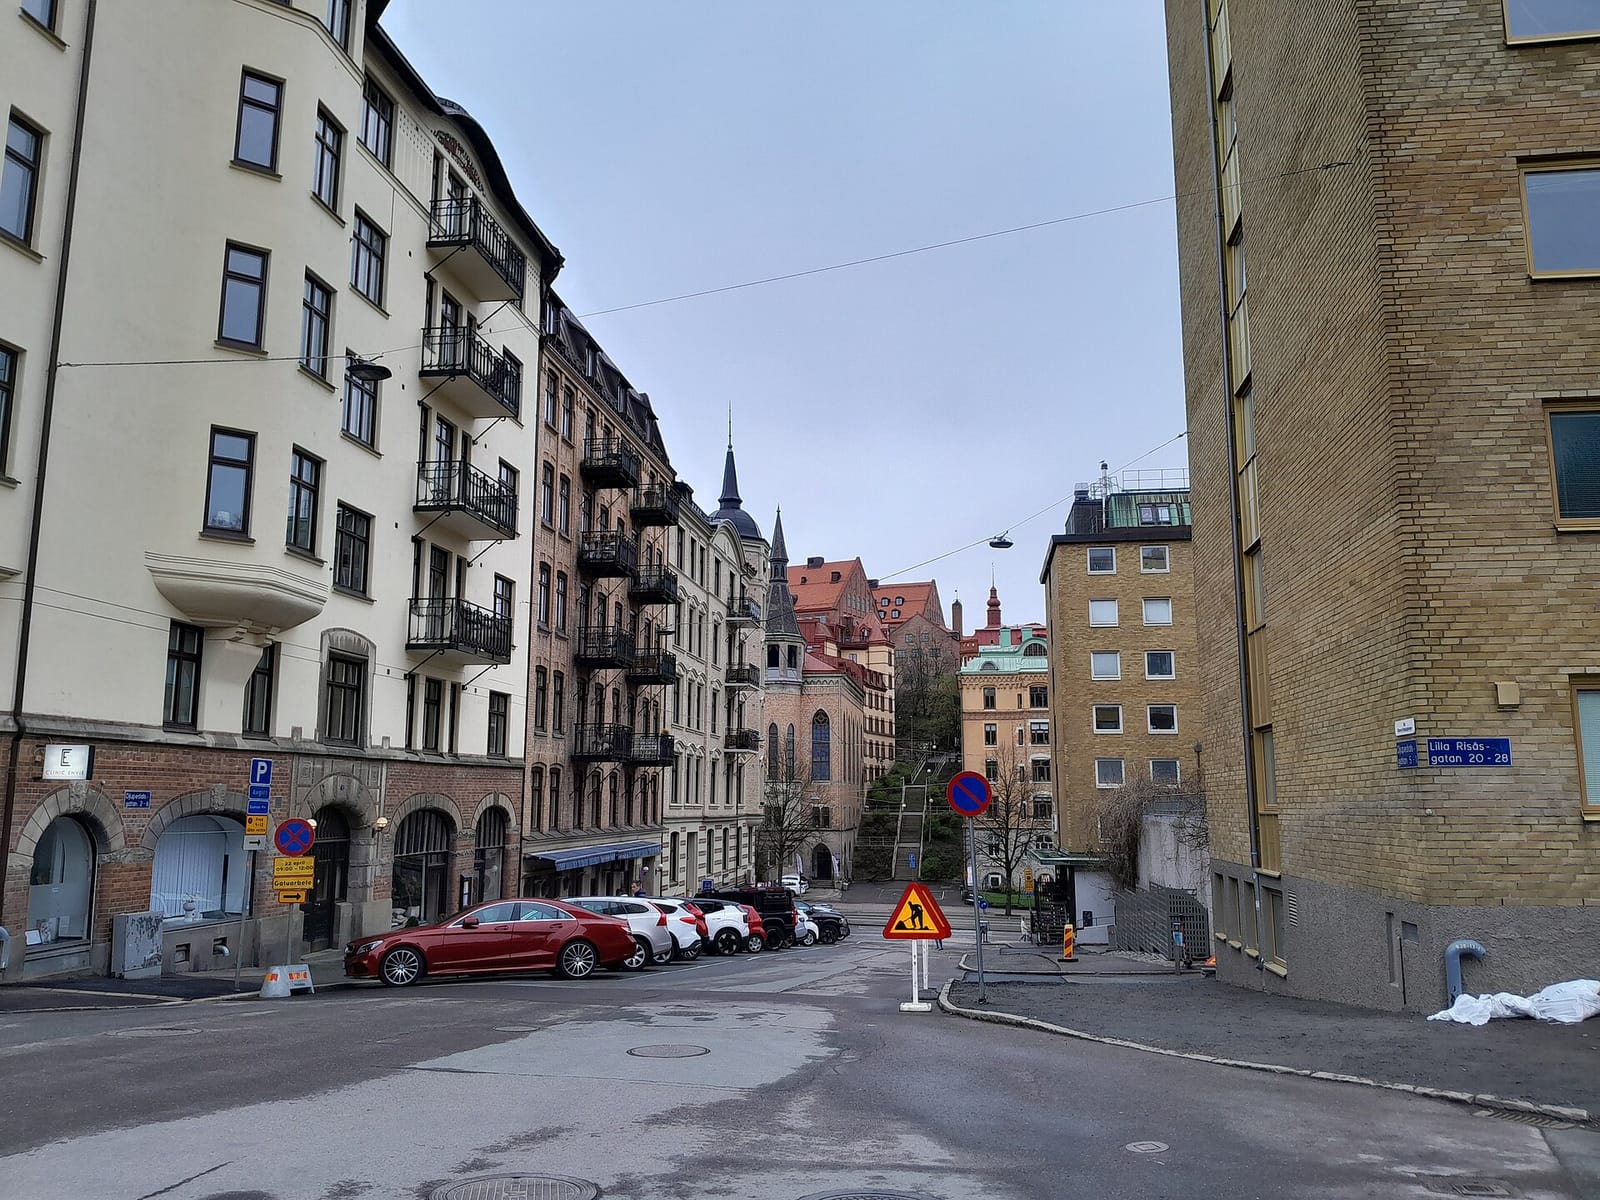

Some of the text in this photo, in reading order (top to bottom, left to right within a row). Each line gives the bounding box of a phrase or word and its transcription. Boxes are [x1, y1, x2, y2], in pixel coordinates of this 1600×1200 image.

[1429, 741, 1490, 751] Lilla Risås-
[1431, 754, 1463, 765] gatan
[1468, 753, 1484, 763] 20
[1494, 753, 1509, 763] 28
[256, 761, 268, 783] P
